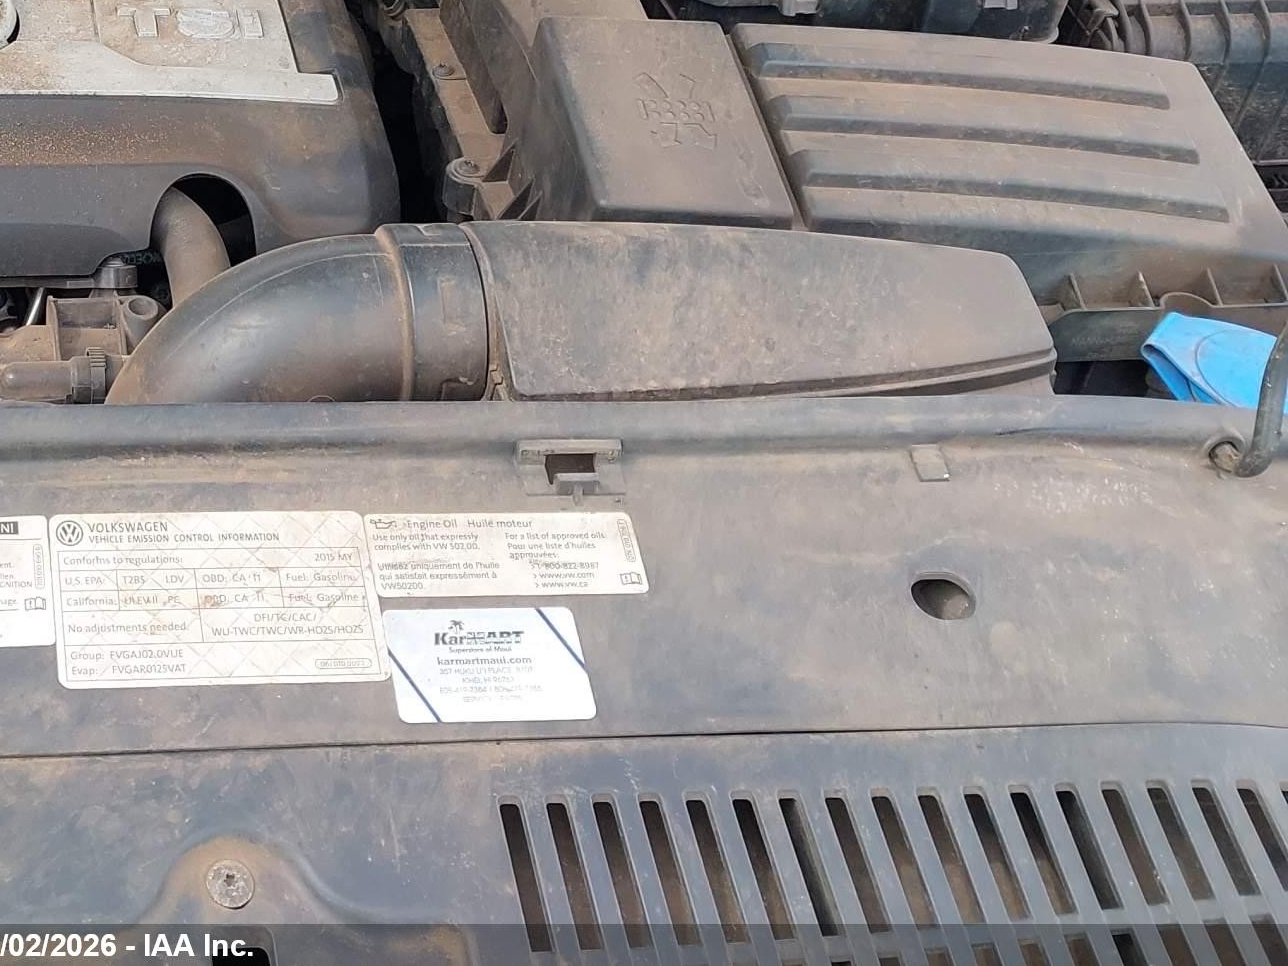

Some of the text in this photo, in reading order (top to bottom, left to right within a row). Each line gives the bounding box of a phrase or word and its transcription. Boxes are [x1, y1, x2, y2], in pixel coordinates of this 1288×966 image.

[88, 522, 168, 532] VOLKSWAGEN
[408, 520, 440, 530] Engine
[128, 535, 169, 543] EMISSION
[218, 533, 279, 541] INFORMATION
[390, 534, 406, 542] only
[441, 533, 478, 542] expressly
[552, 532, 588, 541] approved
[375, 543, 411, 552] complies
[314, 554, 334, 562] 2015
[338, 553, 352, 561] MY
[166, 575, 184, 583] LDV
[232, 574, 245, 582] CA
[380, 573, 392, 582] qui
[68, 623, 146, 634] No adjustments
[70, 652, 104, 662] Group:
[437, 656, 532, 665] karmartmaui.com
[72, 666, 98, 676] Evap:
